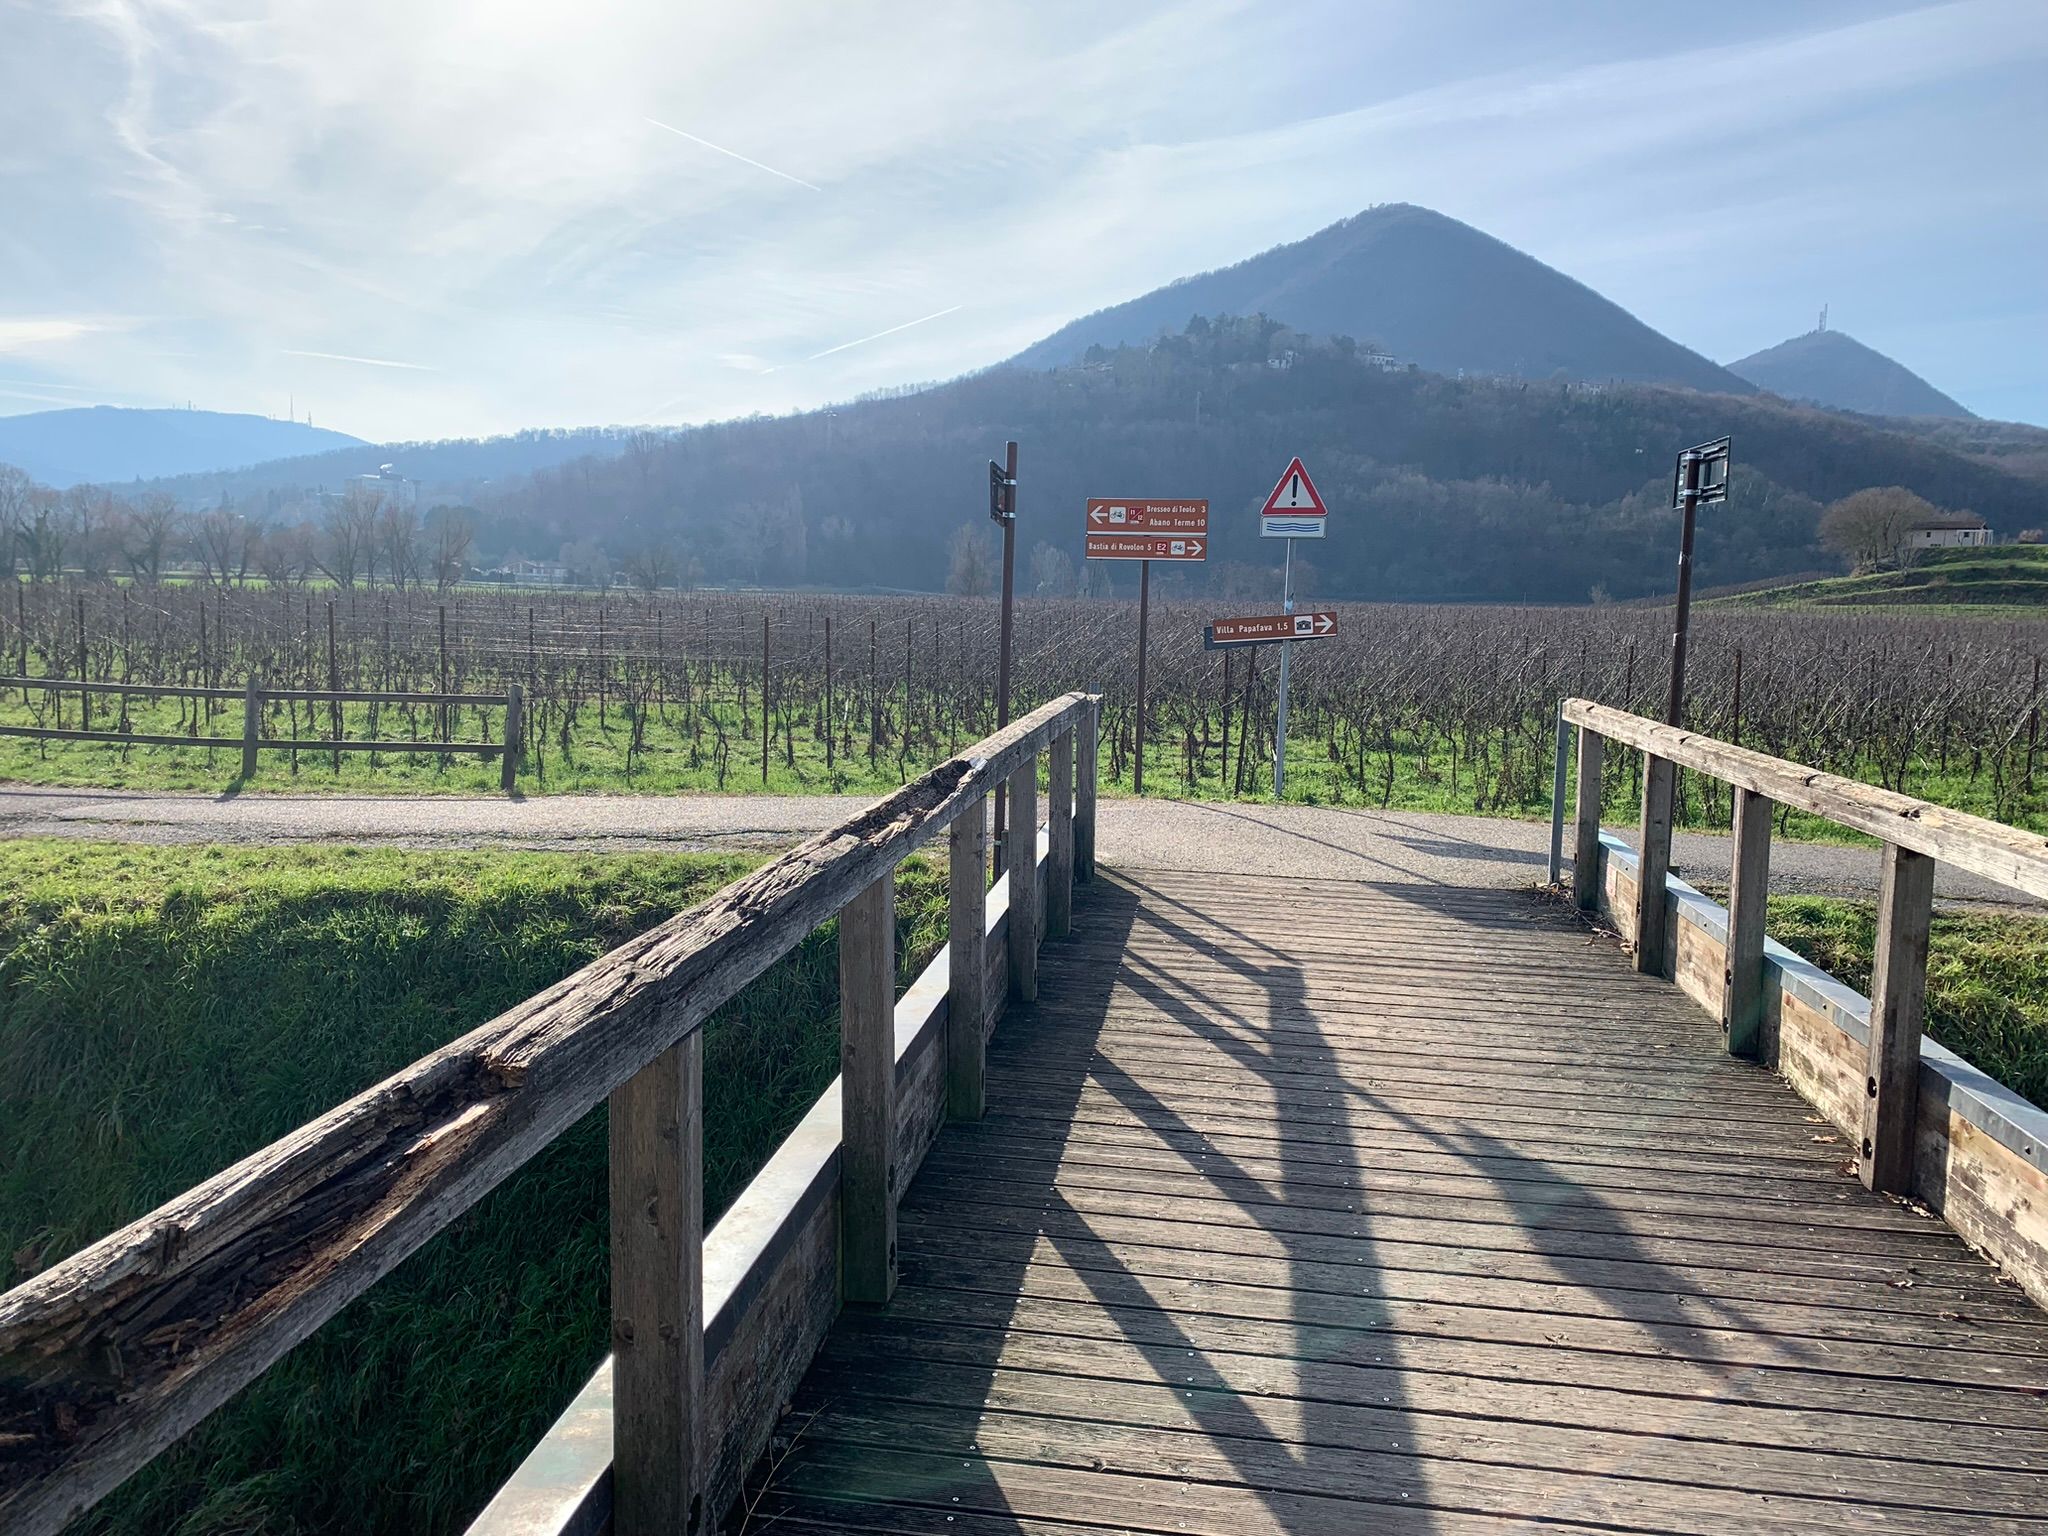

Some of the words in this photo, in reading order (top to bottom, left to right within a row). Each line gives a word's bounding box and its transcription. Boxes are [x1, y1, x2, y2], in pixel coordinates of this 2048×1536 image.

[1179, 505, 1196, 513] Teolo
[1149, 518, 1171, 526] Abano
[1174, 519, 1195, 527] Terme
[1197, 519, 1206, 527] 10
[1088, 542, 1109, 550] Bastia
[1111, 542, 1117, 550] di
[1118, 543, 1145, 551] Rovolon
[1147, 543, 1152, 551] 5
[1156, 543, 1167, 551] E2
[1216, 626, 1234, 634] Villa
[1238, 624, 1272, 633] Papafava
[1277, 622, 1288, 631] 1.5
